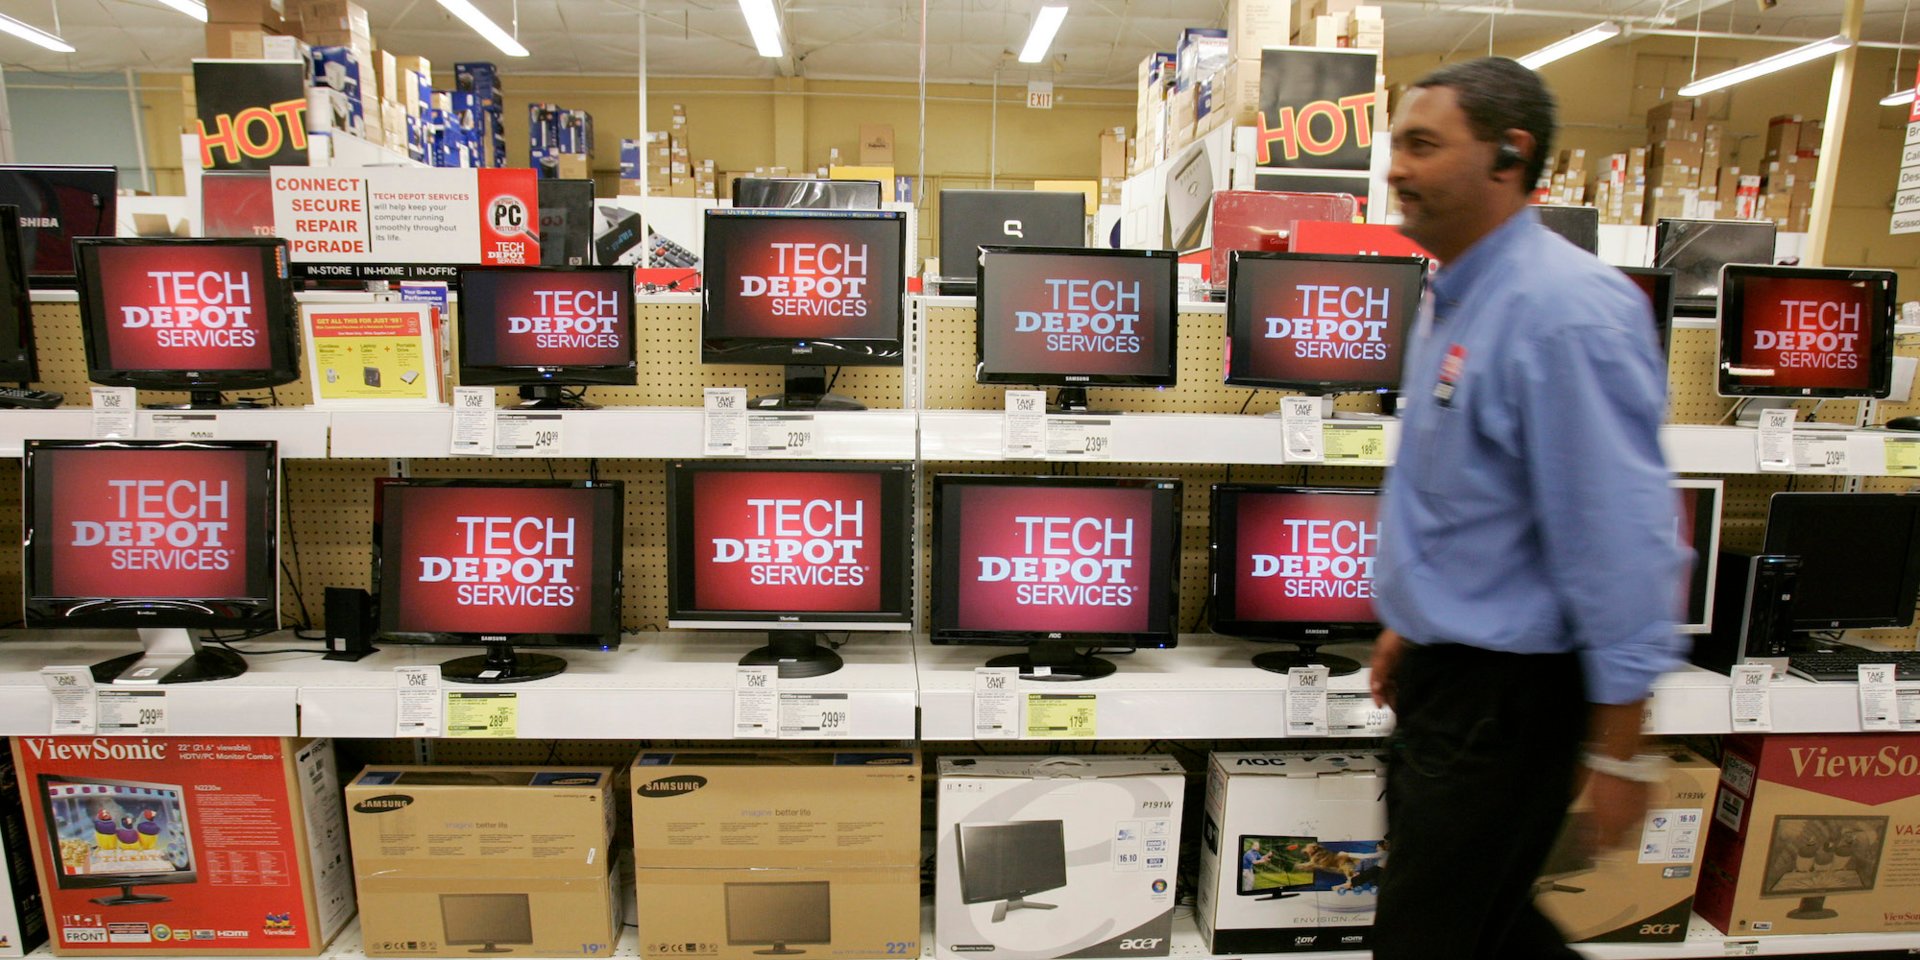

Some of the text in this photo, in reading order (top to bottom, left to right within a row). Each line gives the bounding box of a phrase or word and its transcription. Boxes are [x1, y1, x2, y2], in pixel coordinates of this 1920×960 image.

[1030, 93, 1050, 107] EXIT
[198, 99, 307, 168] HOT
[1256, 92, 1376, 164] HOT
[276, 178, 360, 192] CONNECT
[292, 199, 361, 212] SECURE
[373, 193, 395, 201] TECH
[398, 193, 425, 201] DEPOT
[374, 214, 444, 223] computer running
[389, 204, 406, 212] help
[408, 204, 427, 212] keep
[495, 205, 521, 226] PC
[296, 220, 357, 232] REPAIR
[375, 224, 456, 233] smoothly throughout
[496, 242, 524, 251] TECH
[771, 243, 867, 275] TECH
[307, 266, 352, 275] IN-STORE
[364, 266, 404, 275] IN-HOME
[148, 272, 250, 304] TECH
[740, 275, 866, 298] DEPOT
[1045, 279, 1140, 312] TECH
[533, 291, 618, 316] TECH
[771, 299, 867, 317] SERVICES
[1296, 285, 1390, 319] TECH
[121, 306, 252, 328] DEPOT
[508, 317, 618, 334] DEPOT
[1015, 311, 1139, 334] DEPOT
[1780, 300, 1860, 331] TECH
[157, 330, 256, 347] SERVICES
[1265, 317, 1387, 342] DEPOT
[536, 334, 619, 348] SERVICES
[1046, 334, 1140, 353] SERVICES
[1295, 341, 1386, 360] SERVICES
[1754, 330, 1858, 352] DEPOT
[1779, 352, 1858, 369] SERVICES
[108, 480, 228, 519] TECH
[747, 499, 863, 537] TECH
[71, 521, 228, 547] DEPOT
[456, 516, 574, 556] TECH
[1015, 516, 1133, 556] TECH
[1283, 519, 1382, 554] TECH
[111, 549, 229, 570] SERVICES
[712, 538, 863, 564] DEPOT
[418, 557, 573, 583] DEPOT
[751, 565, 864, 586] SERVICES
[978, 557, 1132, 584] DEPOT
[1252, 555, 1377, 578] DEPOT
[457, 585, 574, 607] SERVICES
[1016, 584, 1132, 606] SERVICES
[24, 738, 165, 760] ViewSonic
[1237, 758, 1286, 766] AOC
[1789, 745, 1920, 778] ViewSo
[646, 781, 699, 791] SAMSUNG
[360, 800, 408, 808] SAMSUNG
[775, 808, 799, 816] better
[800, 808, 811, 816] life
[67, 933, 103, 941] FRONT
[1639, 924, 1680, 934] acer
[1120, 938, 1162, 950] acer
